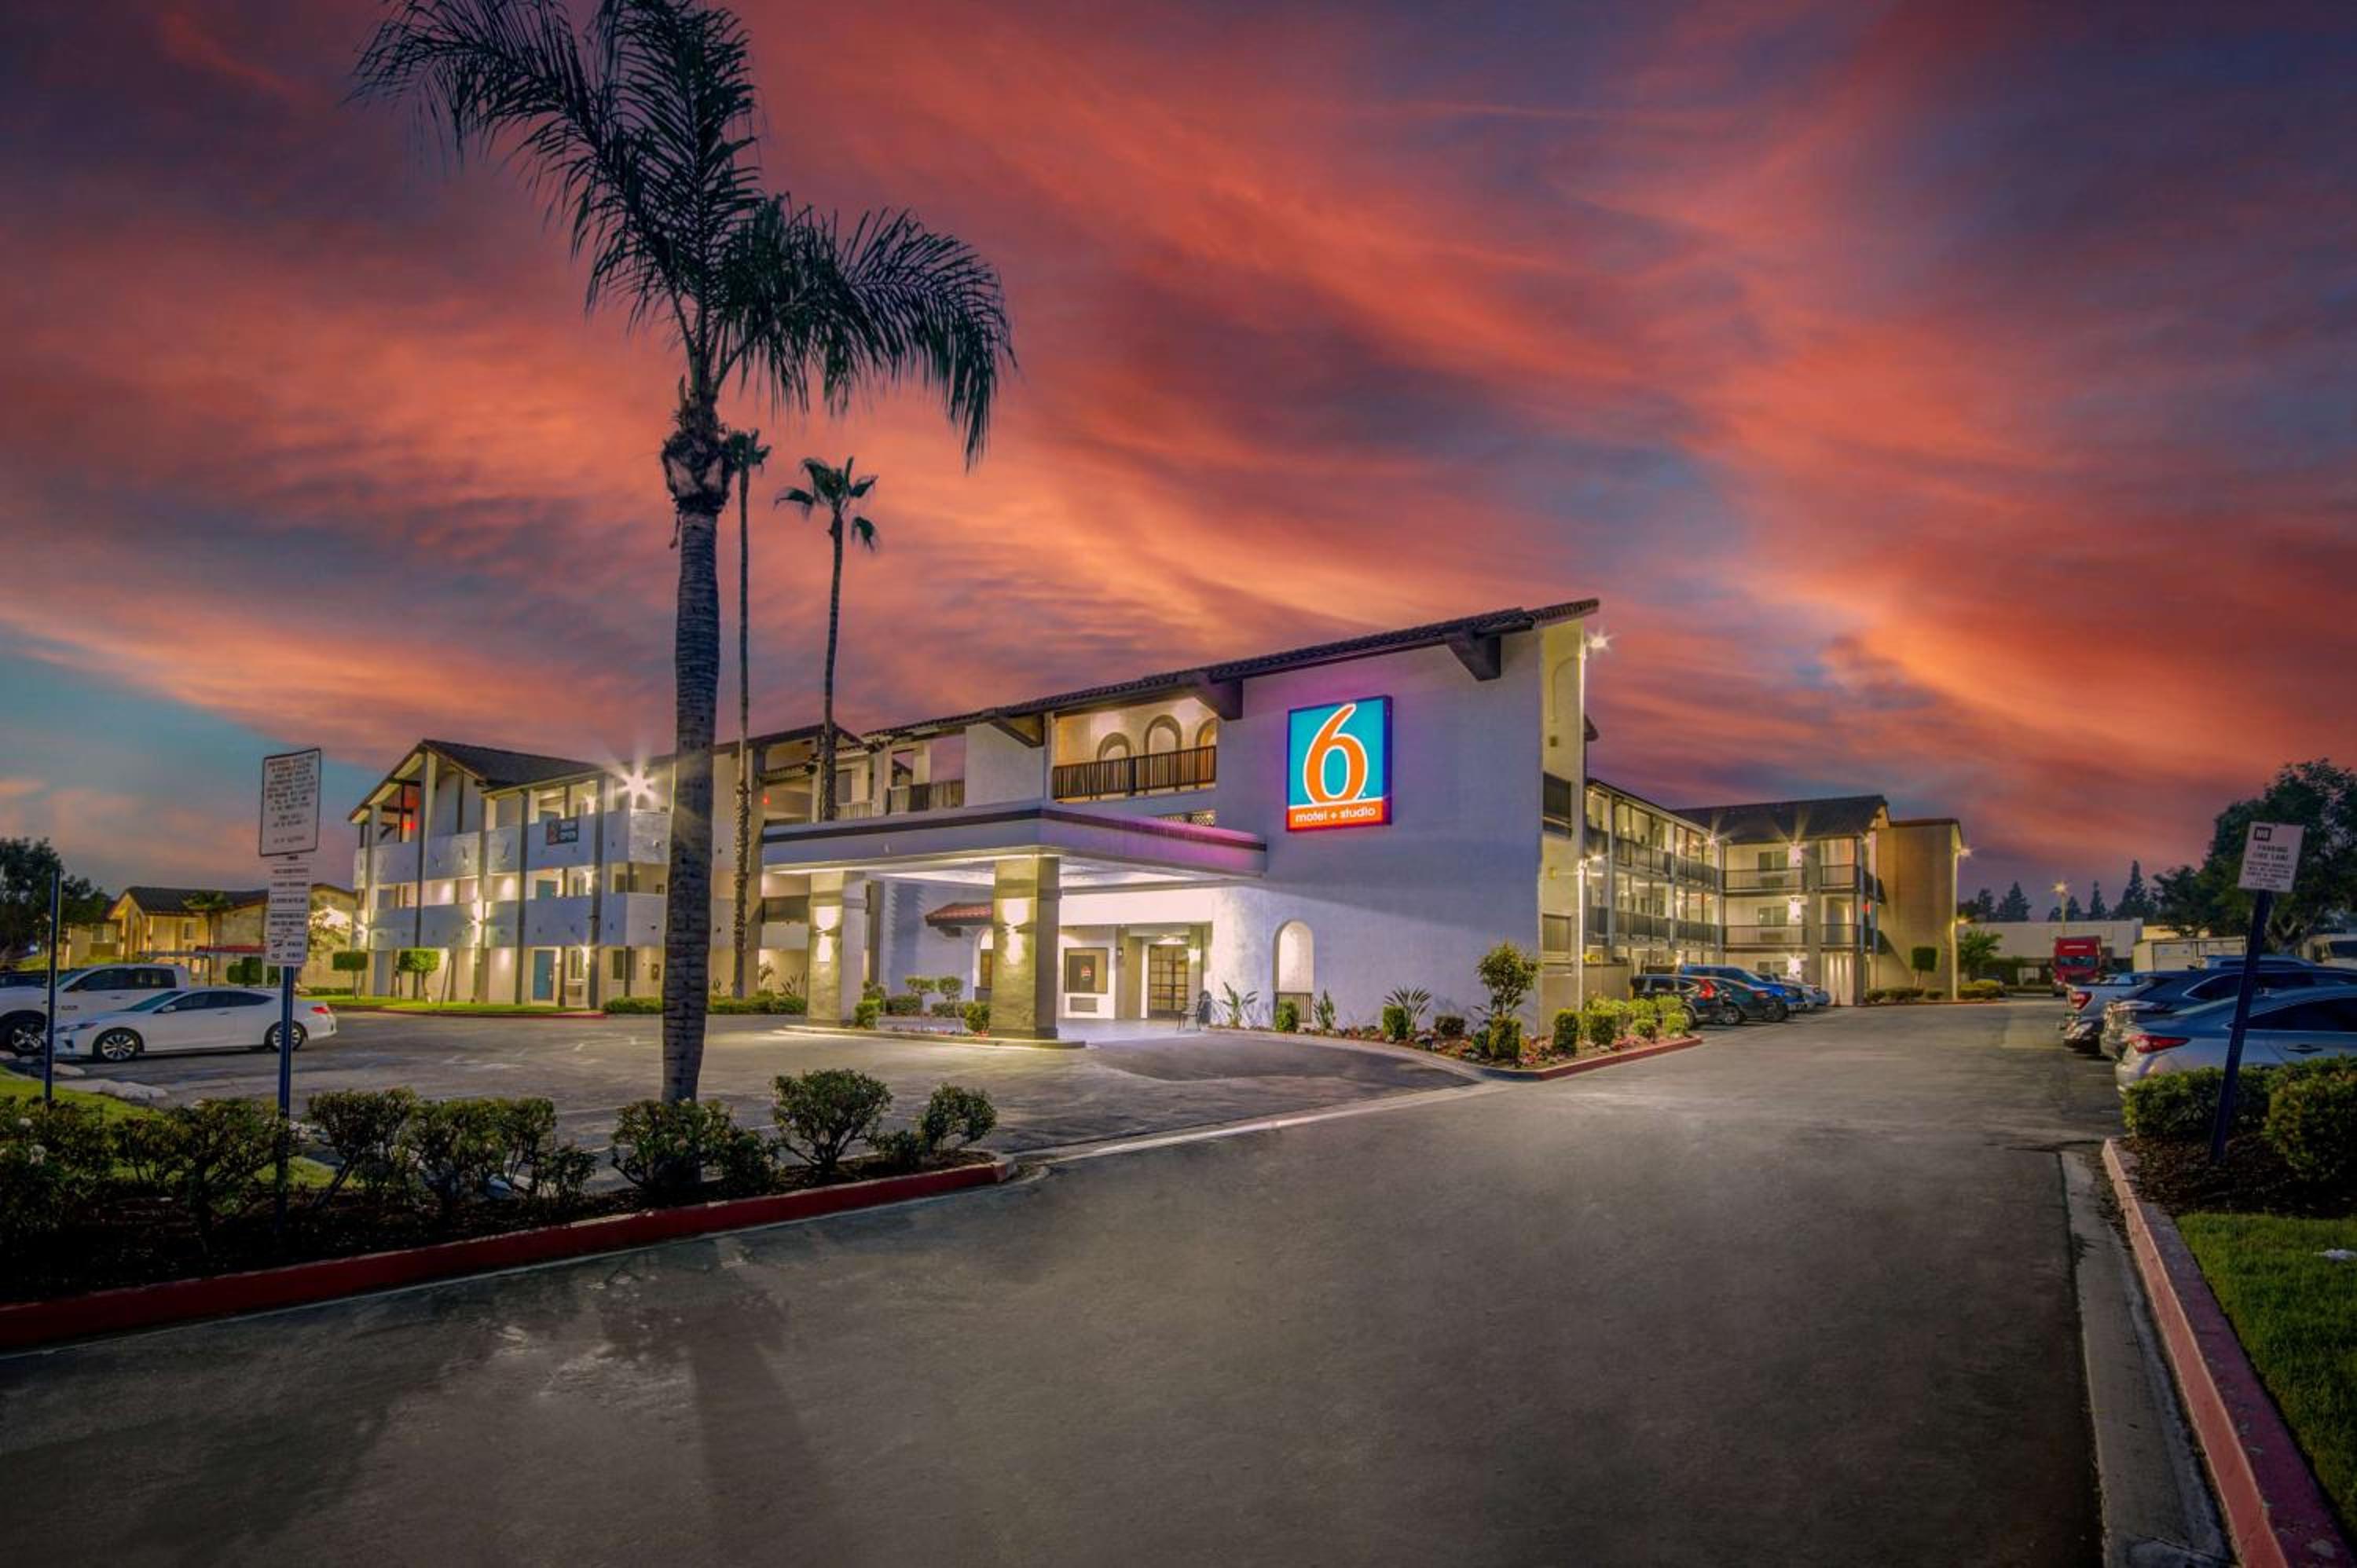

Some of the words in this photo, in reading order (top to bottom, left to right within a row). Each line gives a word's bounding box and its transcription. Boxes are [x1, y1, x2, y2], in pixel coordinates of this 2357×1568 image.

[1303, 703, 1368, 804] 6
[1295, 811, 1327, 823] motel
[1340, 807, 1376, 818] studio
